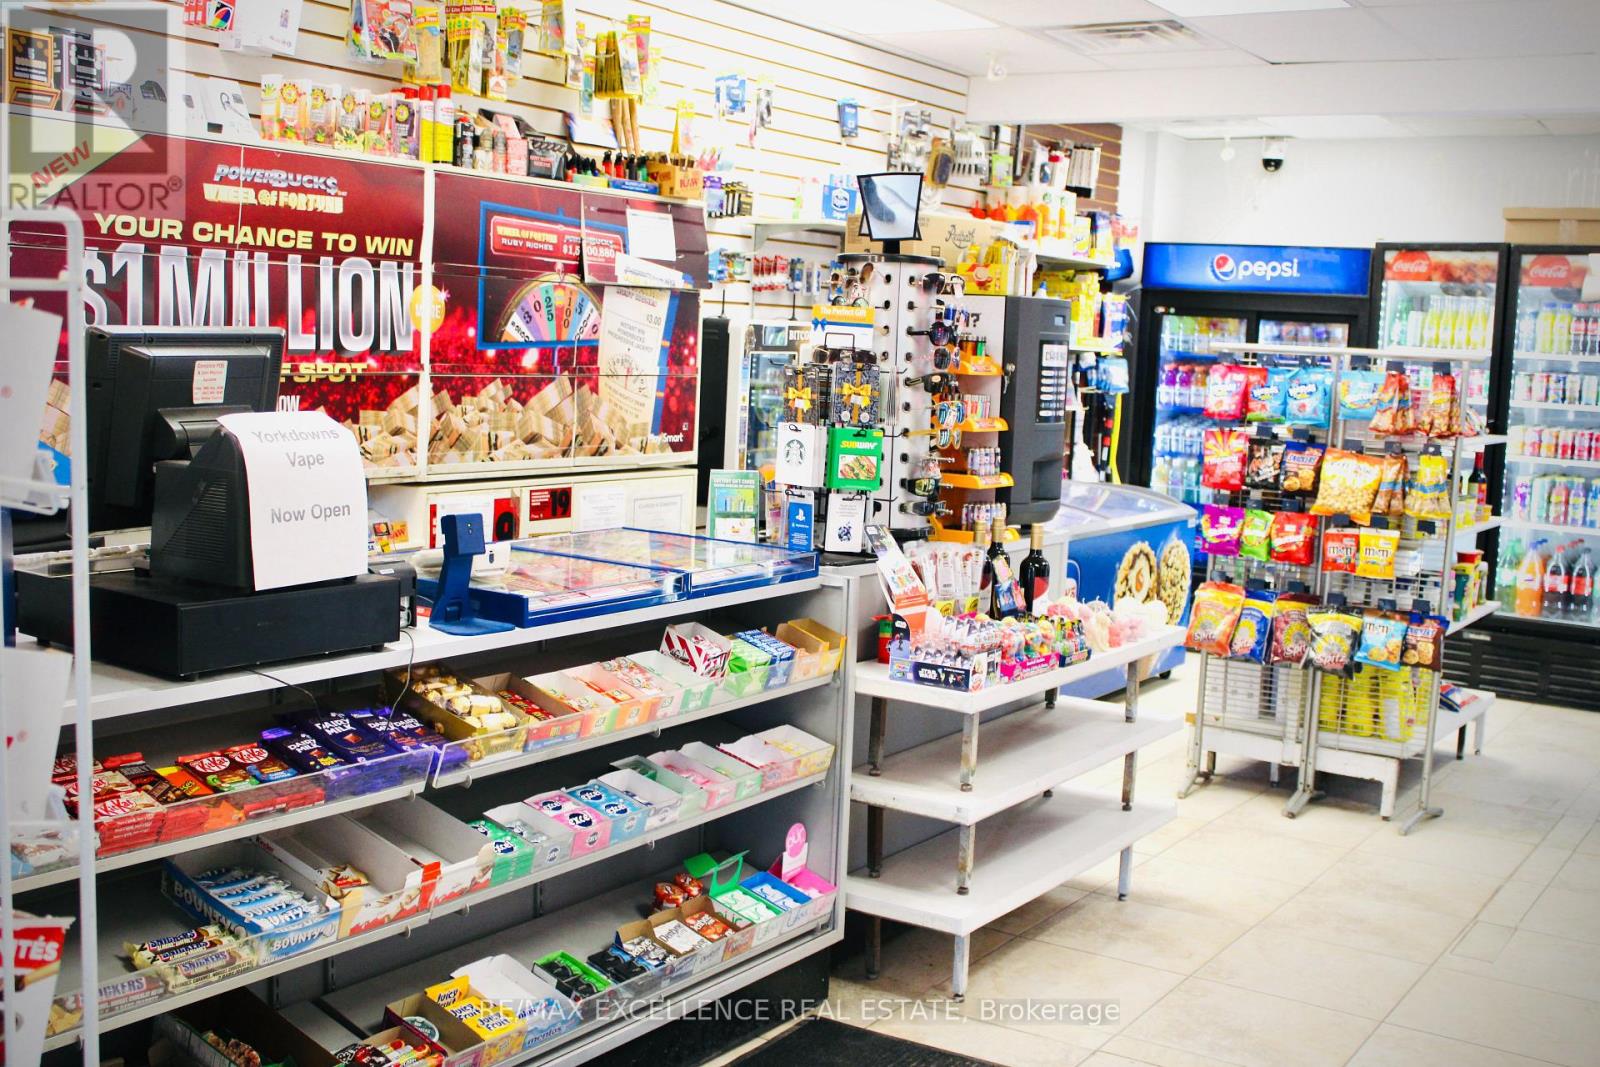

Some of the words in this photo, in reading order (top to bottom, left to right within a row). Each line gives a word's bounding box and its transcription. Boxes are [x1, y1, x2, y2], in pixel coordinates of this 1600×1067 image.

[31, 141, 91, 189] NEW
[94, 213, 183, 240] YOUR
[192, 222, 313, 249] CHANCE
[321, 231, 357, 253] TO
[365, 235, 414, 256] WIN
[501, 238, 524, 247] RUBY
[1239, 258, 1300, 281] pepsi
[157, 243, 415, 351] MILLION
[293, 362, 369, 383] SPOT
[251, 428, 341, 443] Yorkdowns
[840, 440, 878, 450] SUBWAY
[285, 451, 326, 469] Vape
[270, 508, 306, 524] Now
[310, 503, 352, 522] Open
[314, 718, 350, 731] DAIRY
[324, 723, 356, 736] MILK
[367, 719, 395, 729] DAIRY
[393, 717, 418, 727] DAIRY
[402, 721, 424, 731] MILK
[288, 738, 317, 751] DAIRY
[296, 743, 322, 754] MILK
[16, 935, 59, 962] TÉS
[273, 930, 324, 952] BOUNTY
[182, 950, 229, 973] SNICKERS
[436, 988, 459, 1003] Juicy
[450, 1003, 475, 1017] Juicy
[457, 1008, 481, 1021] Fruit
[478, 1011, 501, 1026] Juicy
[485, 1017, 511, 1031] Fruit
[527, 1026, 562, 1047] mentos
